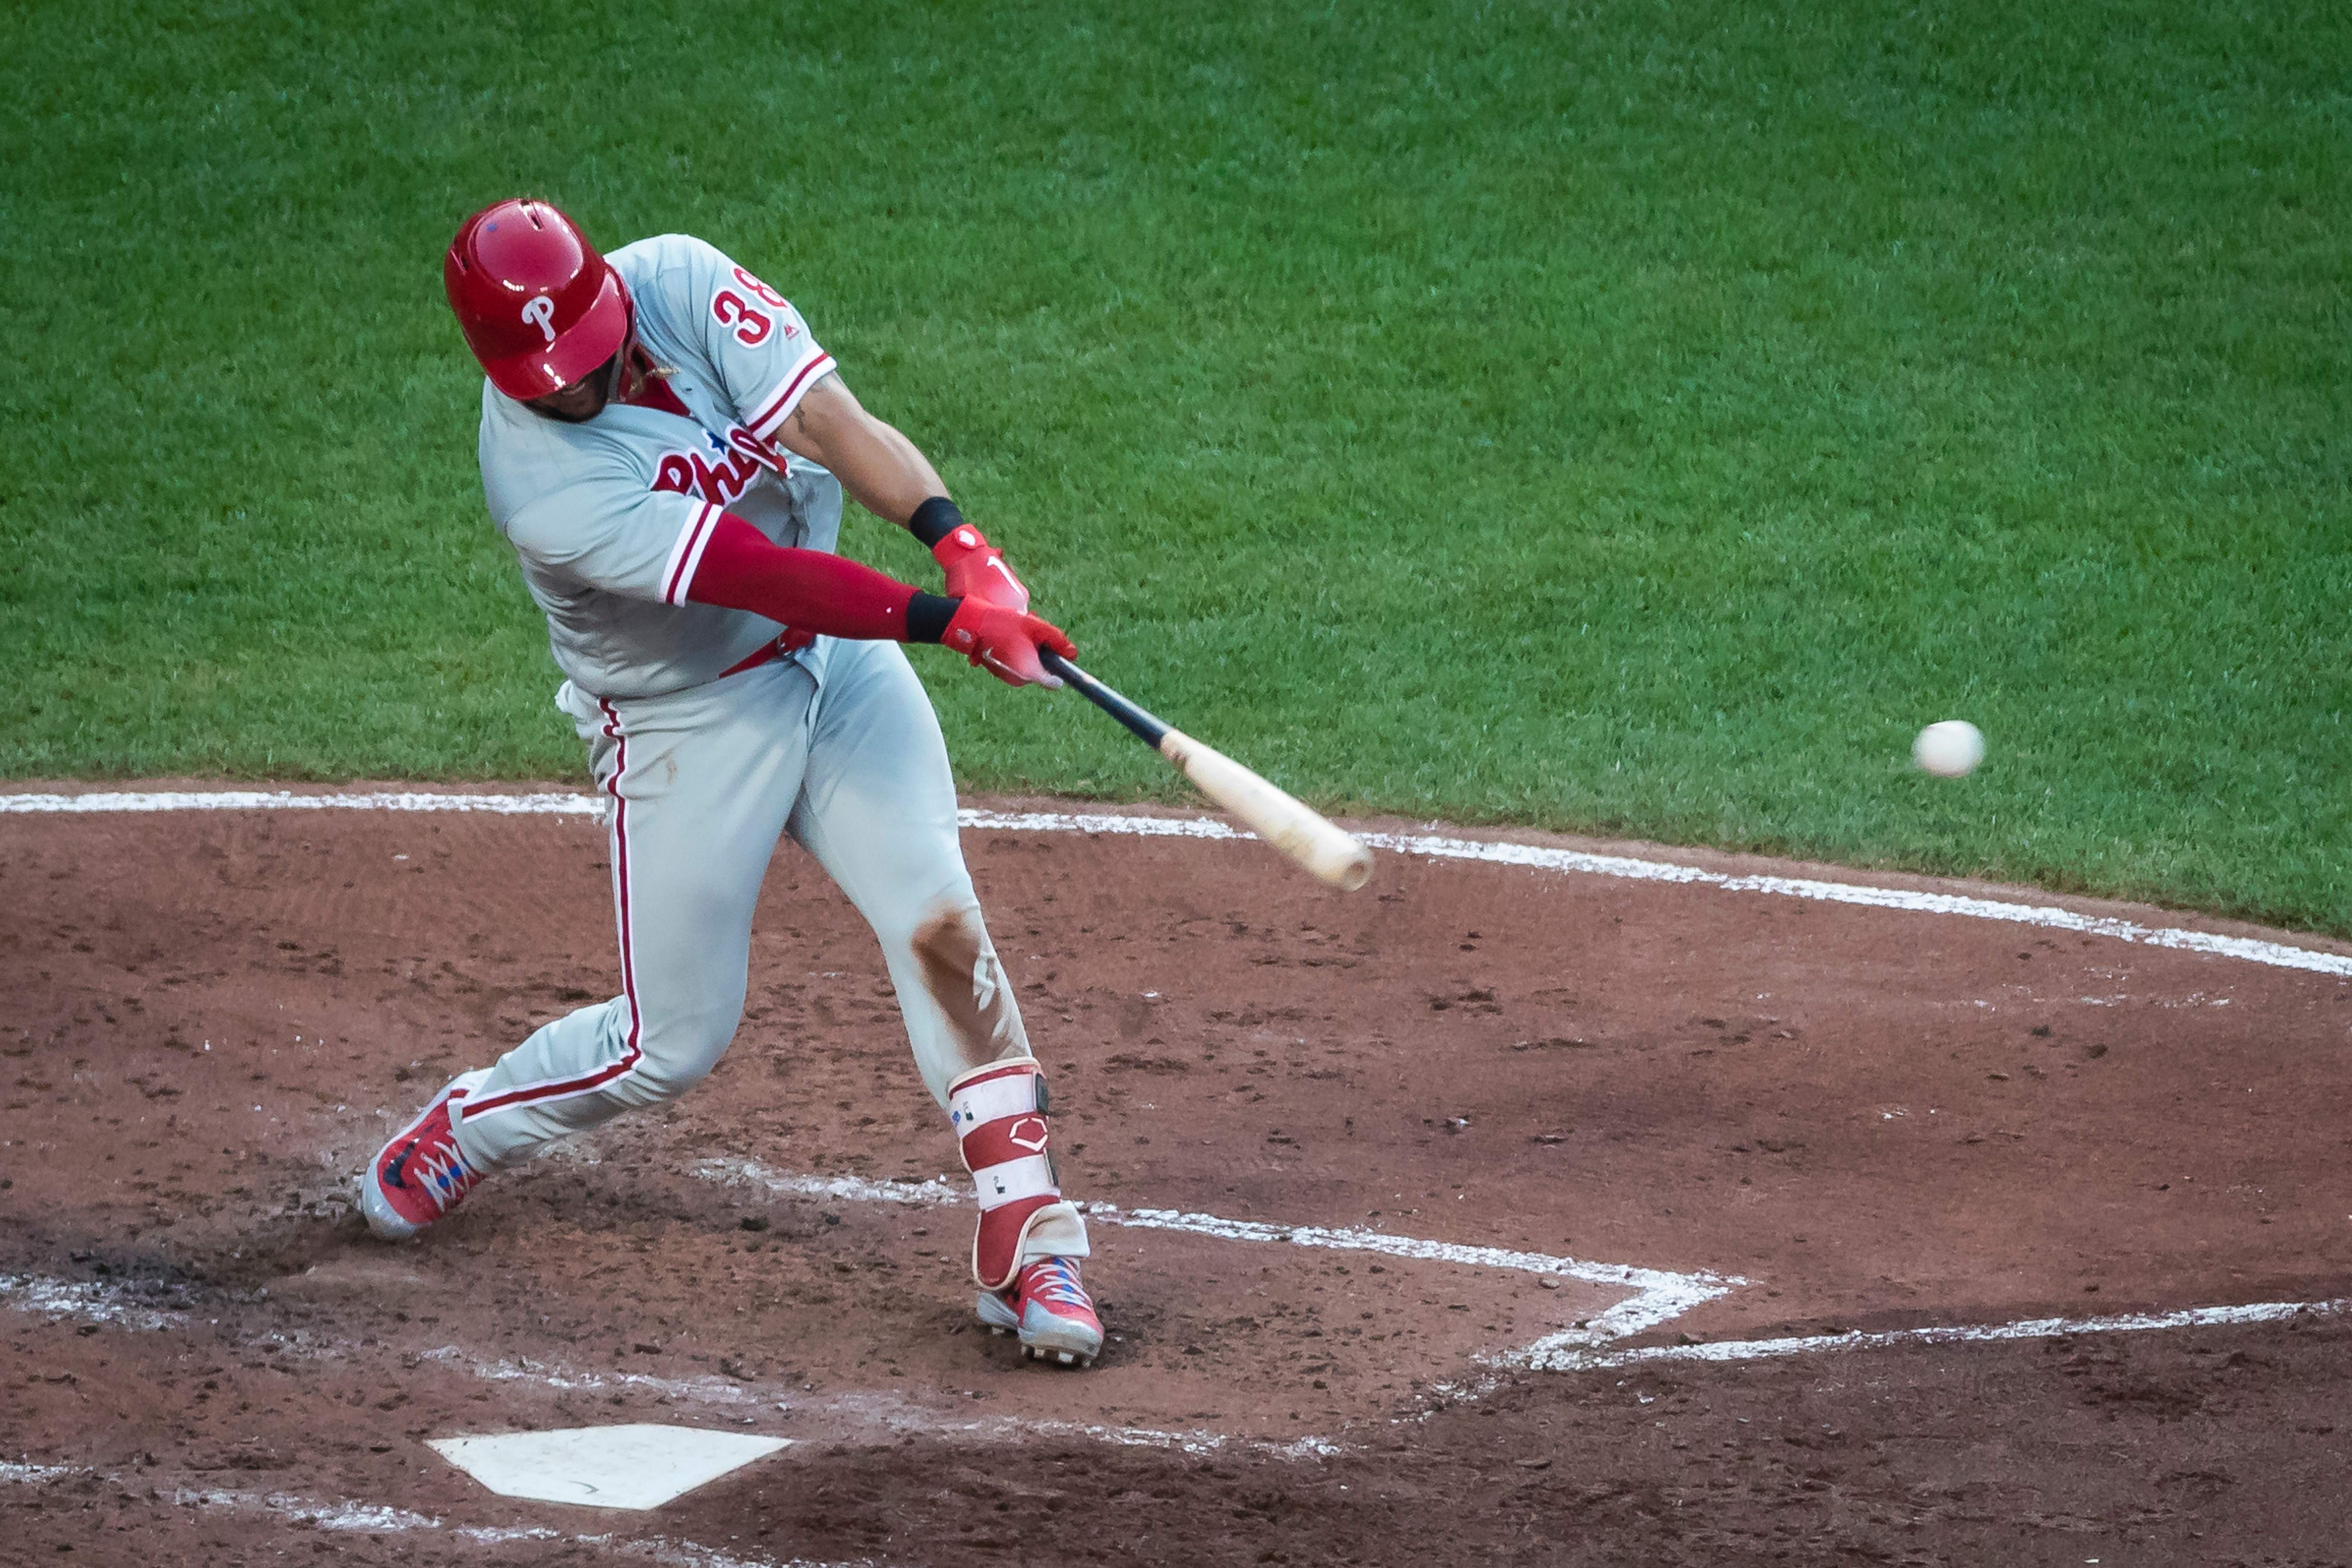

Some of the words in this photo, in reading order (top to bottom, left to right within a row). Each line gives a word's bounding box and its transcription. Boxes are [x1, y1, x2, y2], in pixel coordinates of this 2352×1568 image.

[521, 295, 556, 342] P
[711, 265, 789, 347] 38
[648, 424, 792, 506] Phil
